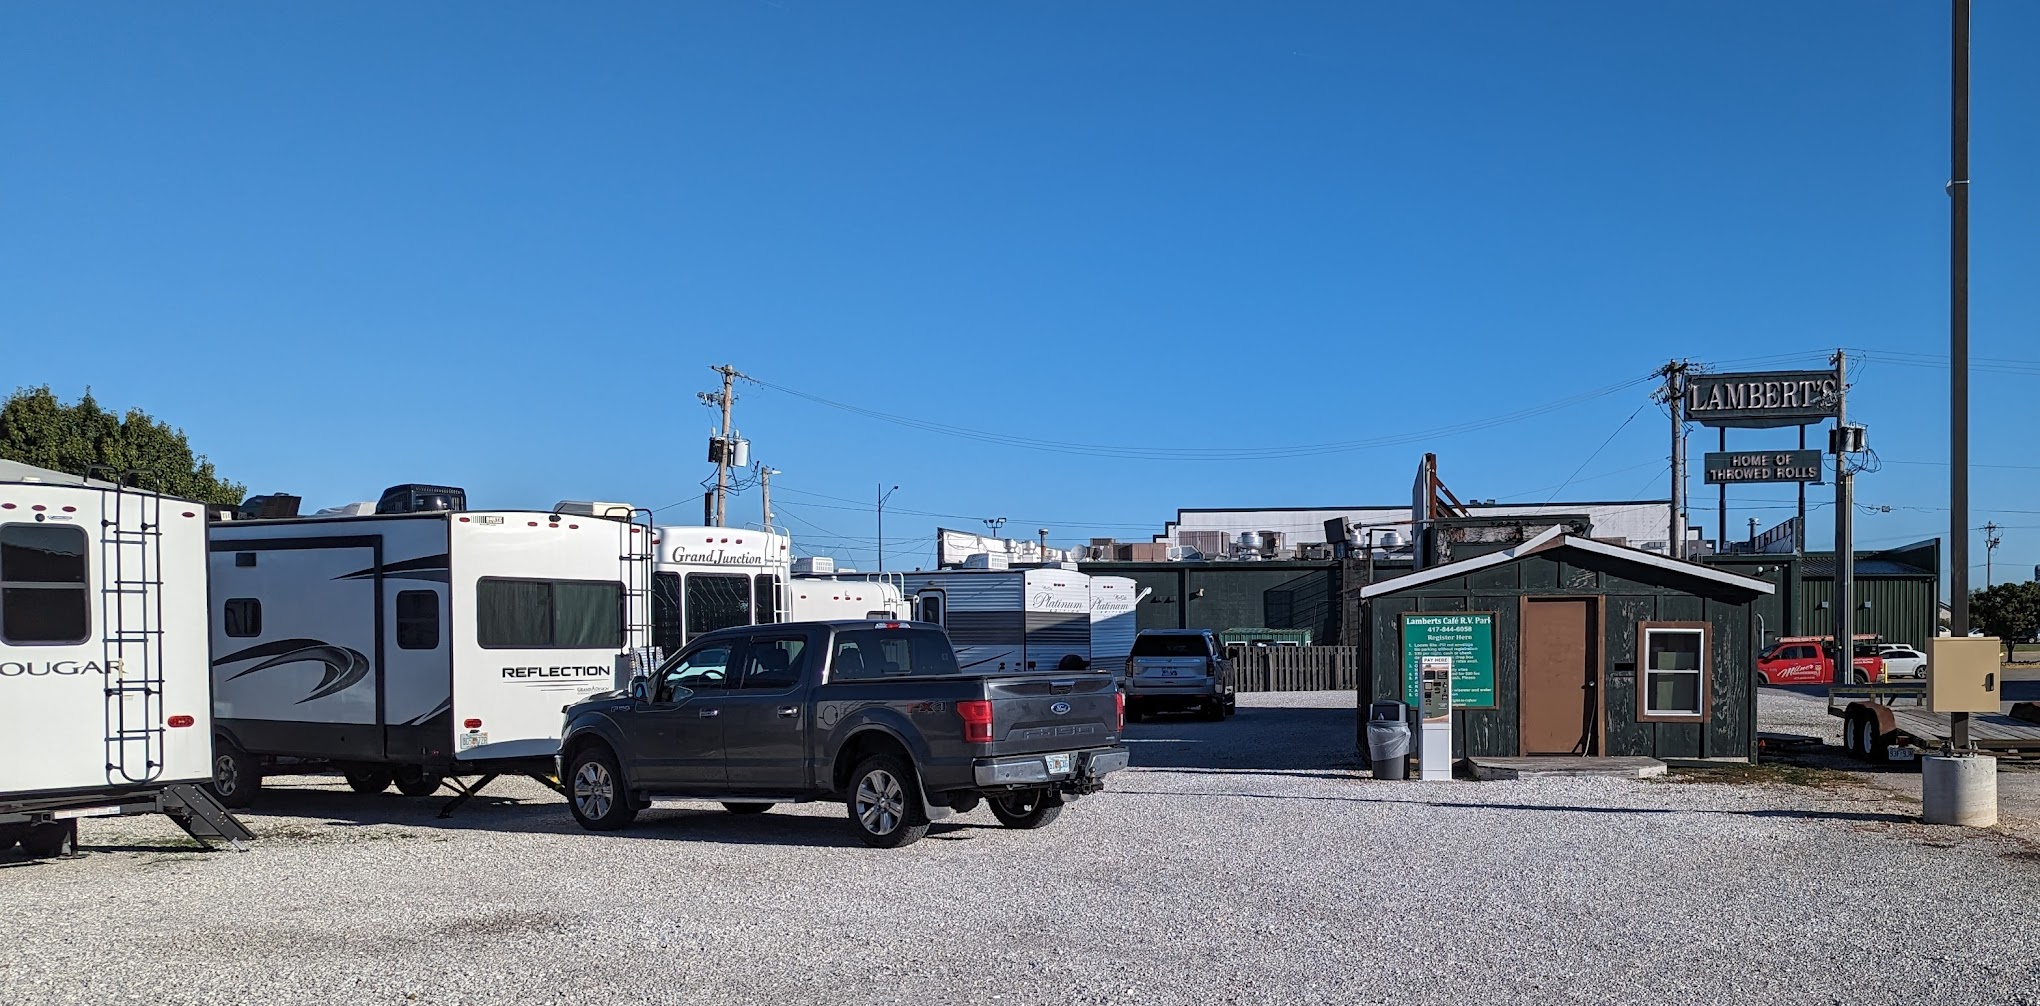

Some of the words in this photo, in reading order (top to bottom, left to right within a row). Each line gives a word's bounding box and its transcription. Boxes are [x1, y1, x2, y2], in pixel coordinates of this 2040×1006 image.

[1690, 379, 1837, 411] LAMBERT'S
[1732, 455, 1769, 467] HOME
[1775, 454, 1794, 465] OF
[1710, 468, 1771, 480] THROWED
[1776, 467, 1817, 478] ROLLS
[672, 546, 715, 563] Grand
[714, 549, 762, 564] Junction
[1032, 592, 1083, 609] Platinum
[1090, 596, 1129, 610] Platinum
[1406, 617, 1442, 625] Lamberts
[1443, 616, 1459, 625] Café
[1475, 616, 1492, 624] Park
[0, 661, 129, 677] OUGAR
[502, 665, 610, 678] REFLECTION
